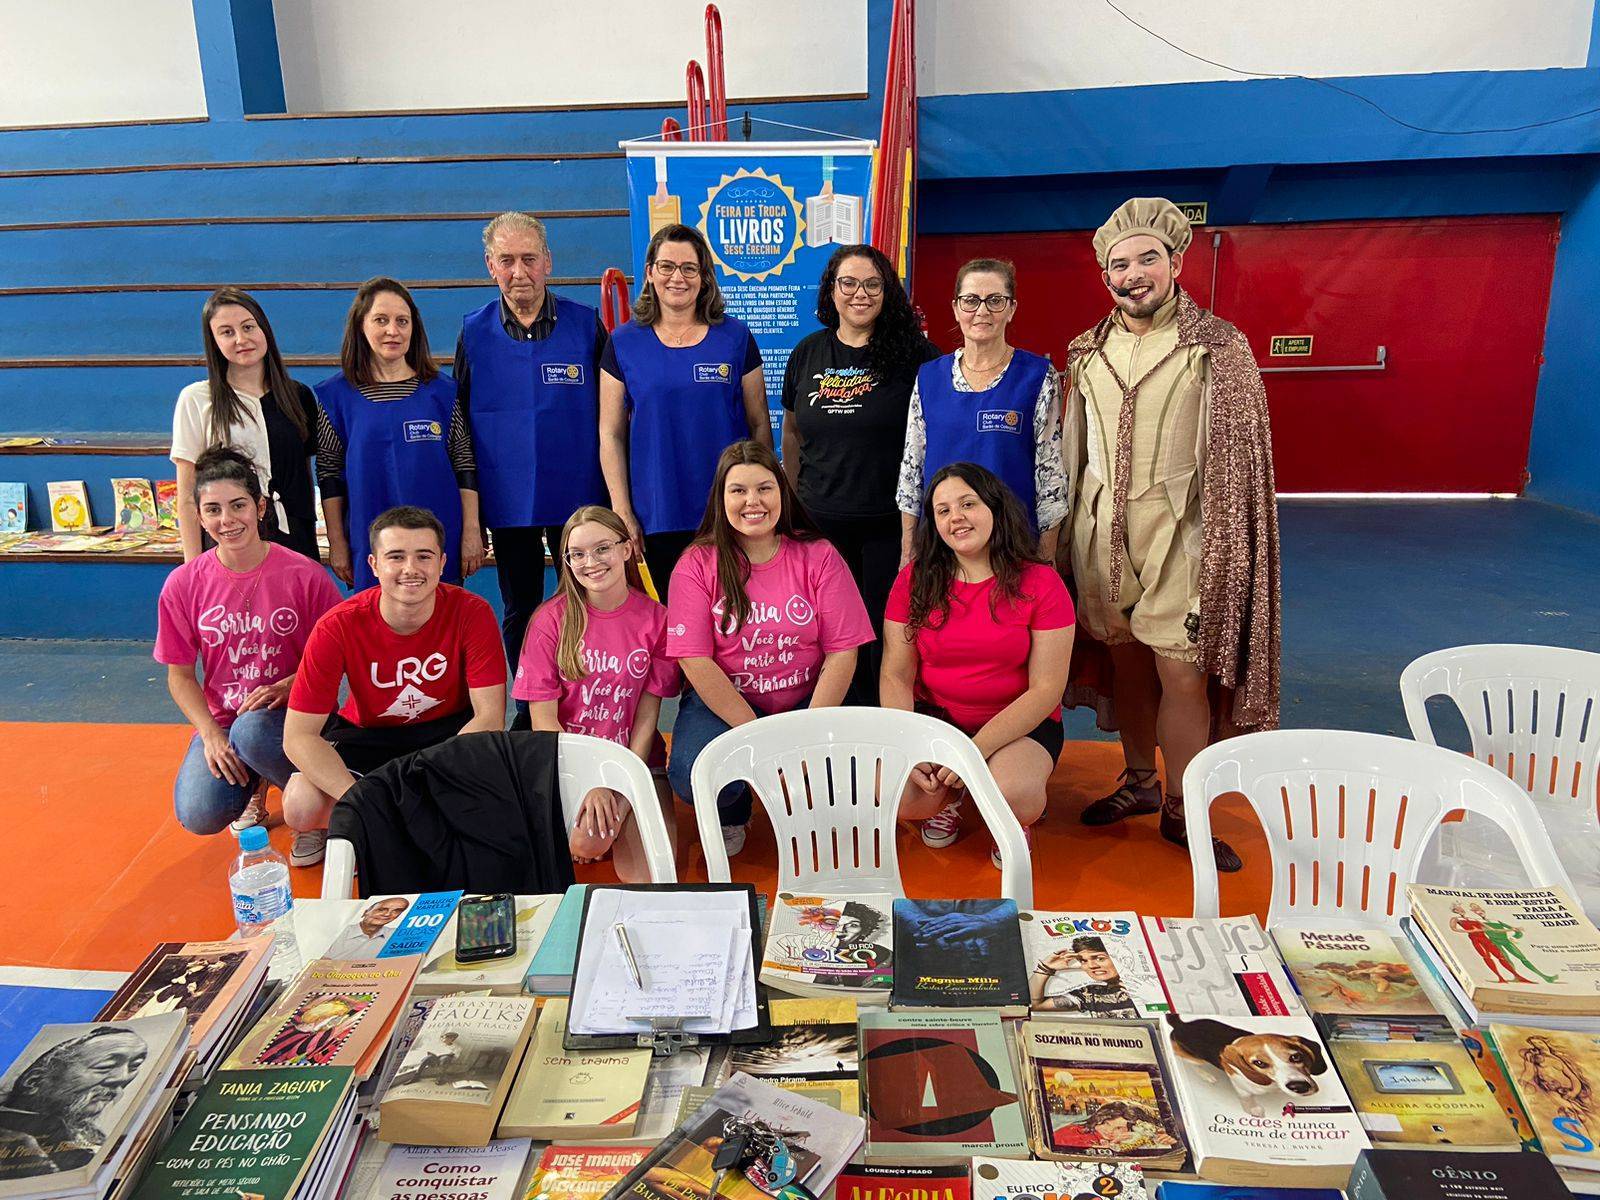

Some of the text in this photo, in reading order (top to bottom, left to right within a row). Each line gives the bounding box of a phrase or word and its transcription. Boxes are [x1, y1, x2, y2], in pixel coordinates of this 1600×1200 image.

[744, 206, 755, 217] DE
[758, 204, 787, 217] TROCA
[1183, 206, 1203, 220] ÍDA
[719, 218, 784, 244] LIVROS
[546, 367, 567, 375] Rotary
[982, 413, 1005, 421] Rotary
[198, 604, 266, 648] Sorria
[742, 628, 799, 652] Você faz
[228, 638, 260, 664] Você
[744, 650, 795, 670] parte do
[264, 666, 279, 678] do
[370, 652, 448, 689] LRG
[581, 678, 633, 706] Você faz
[578, 705, 610, 724] parte
[1426, 888, 1477, 899] MANUAL
[1493, 890, 1556, 899] GINÁSTICA
[1495, 898, 1561, 906] BEM-ESTAR
[406, 913, 444, 928] 100
[1512, 912, 1574, 921] TERCEIRA
[1541, 919, 1580, 928] IDADE
[1300, 932, 1365, 943] Metade
[389, 940, 428, 950] SAÚDE
[1304, 940, 1371, 952] Pássaro
[918, 977, 965, 985] Magnus
[440, 1000, 528, 1011] SEBASTIAN
[432, 1008, 526, 1023] FAULKS
[428, 1021, 518, 1030] HUMAN TRACES
[1034, 1034, 1144, 1049] SOZINHA NO MUNDO
[543, 1056, 630, 1066] sem trauma
[218, 1079, 332, 1096] TANIA ZAGURY
[772, 1097, 814, 1119] Alice Sebold
[1370, 1102, 1486, 1110] ALLEGRA GOODMAN
[199, 1111, 307, 1131] PENSANDO
[1214, 1114, 1235, 1126] Os
[1286, 1121, 1336, 1130] nunca
[1208, 1124, 1350, 1140] deixam de amar
[189, 1129, 292, 1155] EDUCAÇÃO
[995, 1141, 1024, 1149] proust
[402, 1144, 518, 1154] Allan & Barbara Pease
[165, 1153, 291, 1170] COM OS PÉS NO CHÃO
[550, 1152, 643, 1167] JOSÉ MAURO
[423, 1162, 482, 1175] Como
[562, 1166, 582, 1178] DE
[864, 1167, 906, 1175] LOURENÇO
[1431, 1165, 1499, 1181] GÊNIO
[395, 1174, 499, 1190] conquistar
[1006, 1183, 1055, 1194] EU FICO
[1099, 1178, 1118, 1195] 2
[390, 1191, 489, 1200] as pessoas
